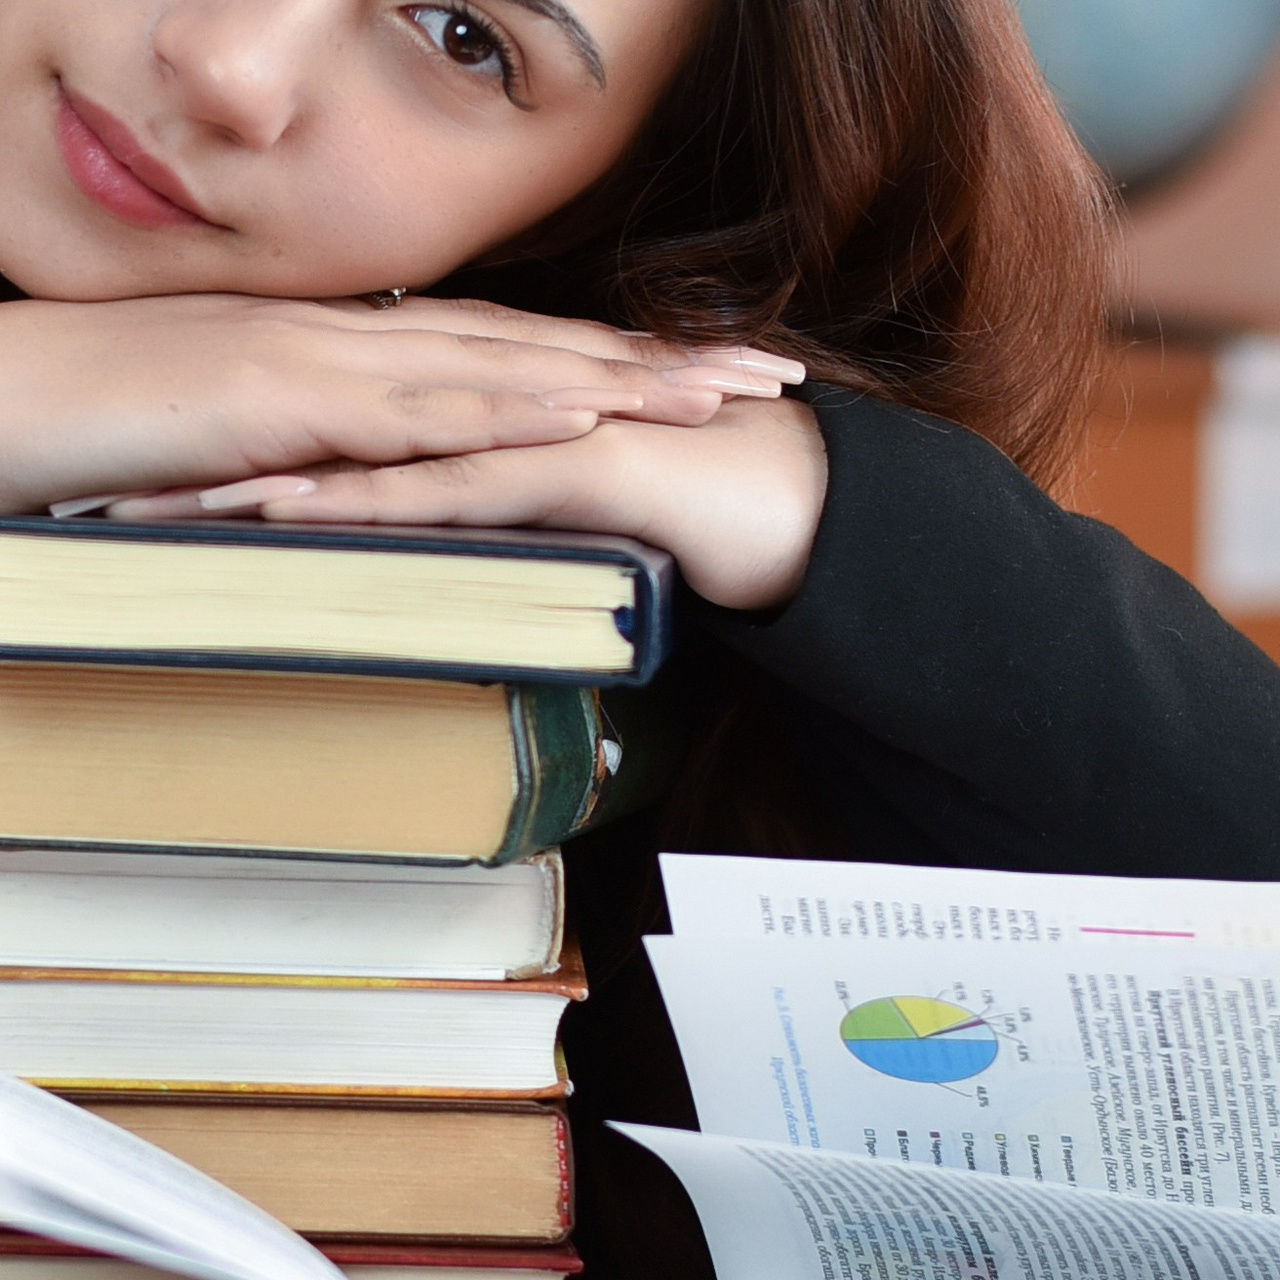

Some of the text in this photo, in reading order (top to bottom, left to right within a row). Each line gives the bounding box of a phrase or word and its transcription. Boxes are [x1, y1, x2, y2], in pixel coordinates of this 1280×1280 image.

[1106, 993, 1132, 1051] территории
[1145, 990, 1174, 1049] Иркутский
[1165, 998, 1193, 1050] Иркутской
[1223, 990, 1245, 1041] Иркутская
[1122, 1053, 1144, 1106] выявлено
[1136, 1030, 1160, 1101] северо-запад,
[1179, 1051, 1197, 1093] области
[1217, 1048, 1230, 1066] том
[1236, 1042, 1253, 1082] область
[1252, 1028, 1272, 1082] бассейнов,
[770, 1057, 796, 1109] Иркутской
[1156, 1052, 1187, 1122] угленосный
[1197, 1068, 1221, 1120] развития.
[1221, 1068, 1237, 1098] числе
[1260, 1084, 1280, 1127] Кувейта
[1085, 1064, 1114, 1156] Усть-Ордынское
[1132, 1108, 1149, 1141] около
[1151, 1104, 1163, 1117] от
[1188, 1094, 1208, 1150] находятся
[1208, 1122, 1226, 1148] (Рис.
[1239, 1083, 1263, 1150] располагает
[1061, 1144, 1076, 1182] Твердые
[1115, 1126, 1137, 1191] Мугунское,
[1139, 1143, 1155, 1159] 40
[1151, 1120, 1173, 1173] Иркутска
[1175, 1126, 1195, 1176] бассейн
[1194, 1152, 1211, 1174] три
[1213, 1151, 1231, 1165] 7).
[1229, 1109, 1252, 1198] минеральными,
[1253, 1151, 1269, 1185] всеми
[1161, 1176, 1175, 1190] до
[891, 1251, 905, 1264] от
[894, 1263, 911, 1277] 30
